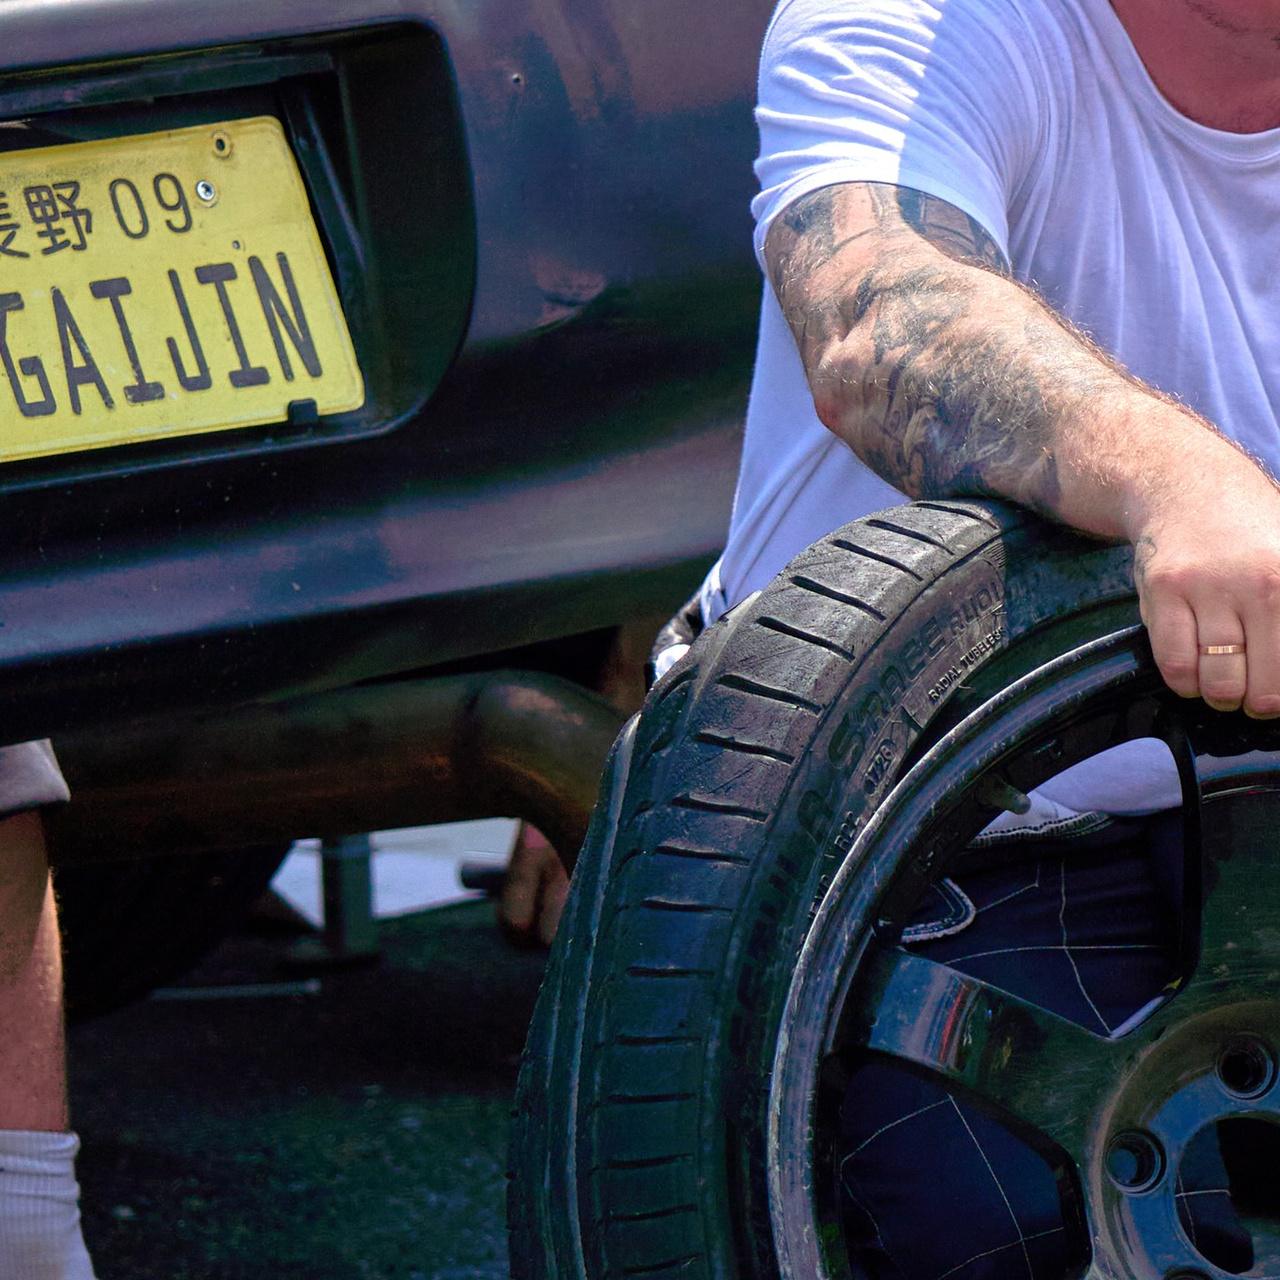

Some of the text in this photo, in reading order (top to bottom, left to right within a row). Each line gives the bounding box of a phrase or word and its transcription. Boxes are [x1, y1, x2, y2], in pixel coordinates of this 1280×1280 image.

[109, 172, 193, 240] 09
[0, 251, 323, 418] GAIJIN
[928, 626, 1005, 703] RADIAL TUBELESS
